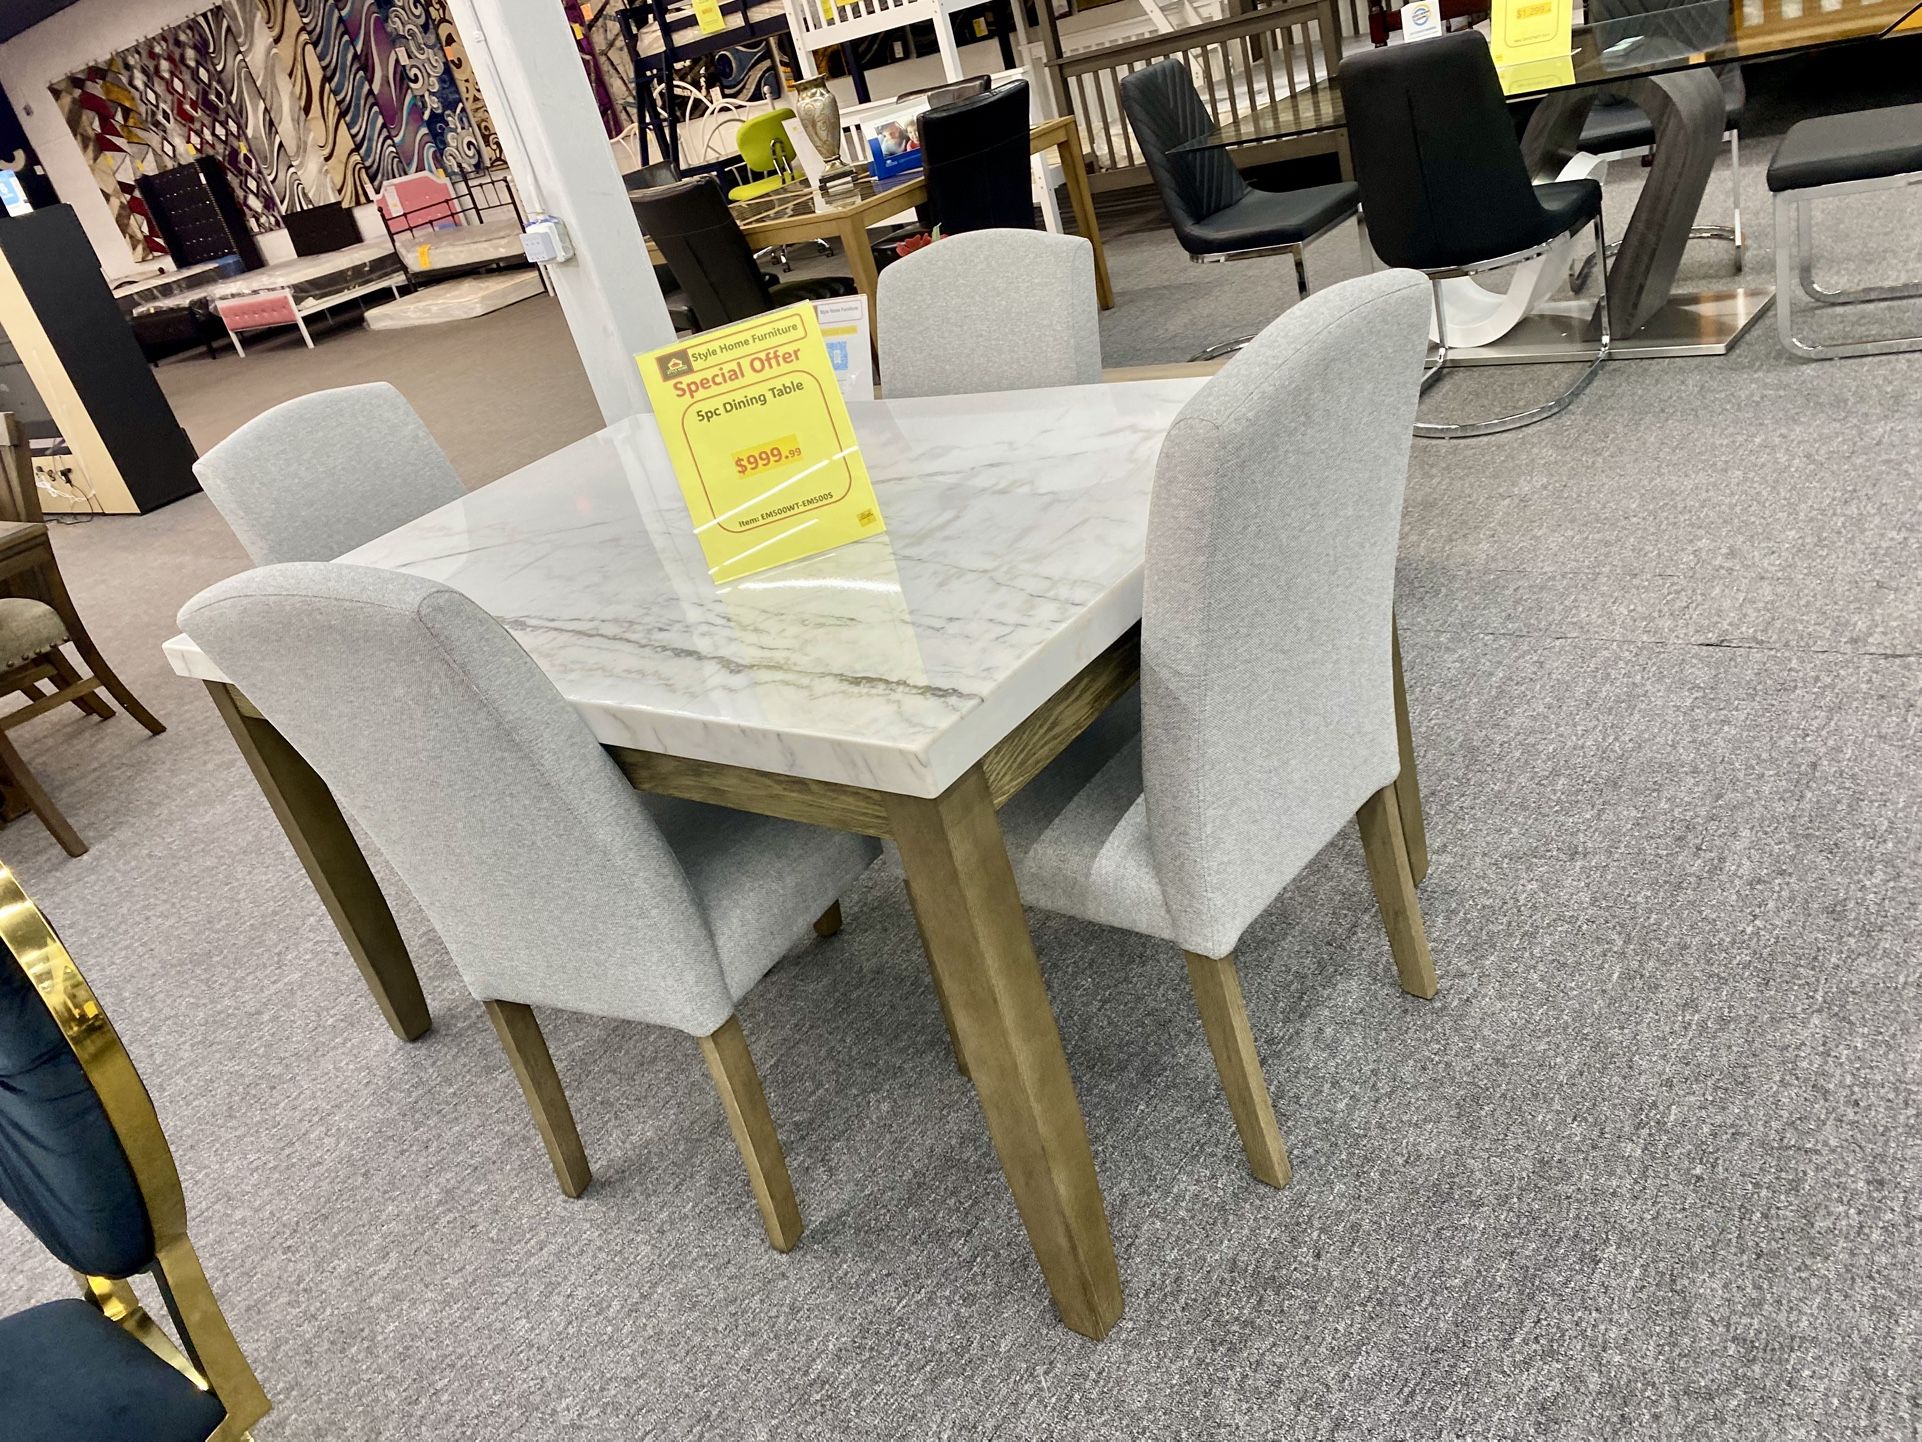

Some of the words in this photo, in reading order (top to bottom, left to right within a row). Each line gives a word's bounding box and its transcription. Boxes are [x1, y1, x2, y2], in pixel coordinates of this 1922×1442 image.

[691, 348, 718, 362] Style
[719, 338, 750, 354] Home
[751, 323, 798, 343] Furniture
[672, 361, 745, 399] Special
[749, 348, 801, 374] Offer
[696, 407, 721, 423] 5pc
[722, 393, 768, 414] Dining
[767, 380, 805, 399] Table
[735, 447, 801, 475] $999.99
[738, 517, 760, 528] Item:
[760, 492, 834, 520] EM500WT-EM500S
